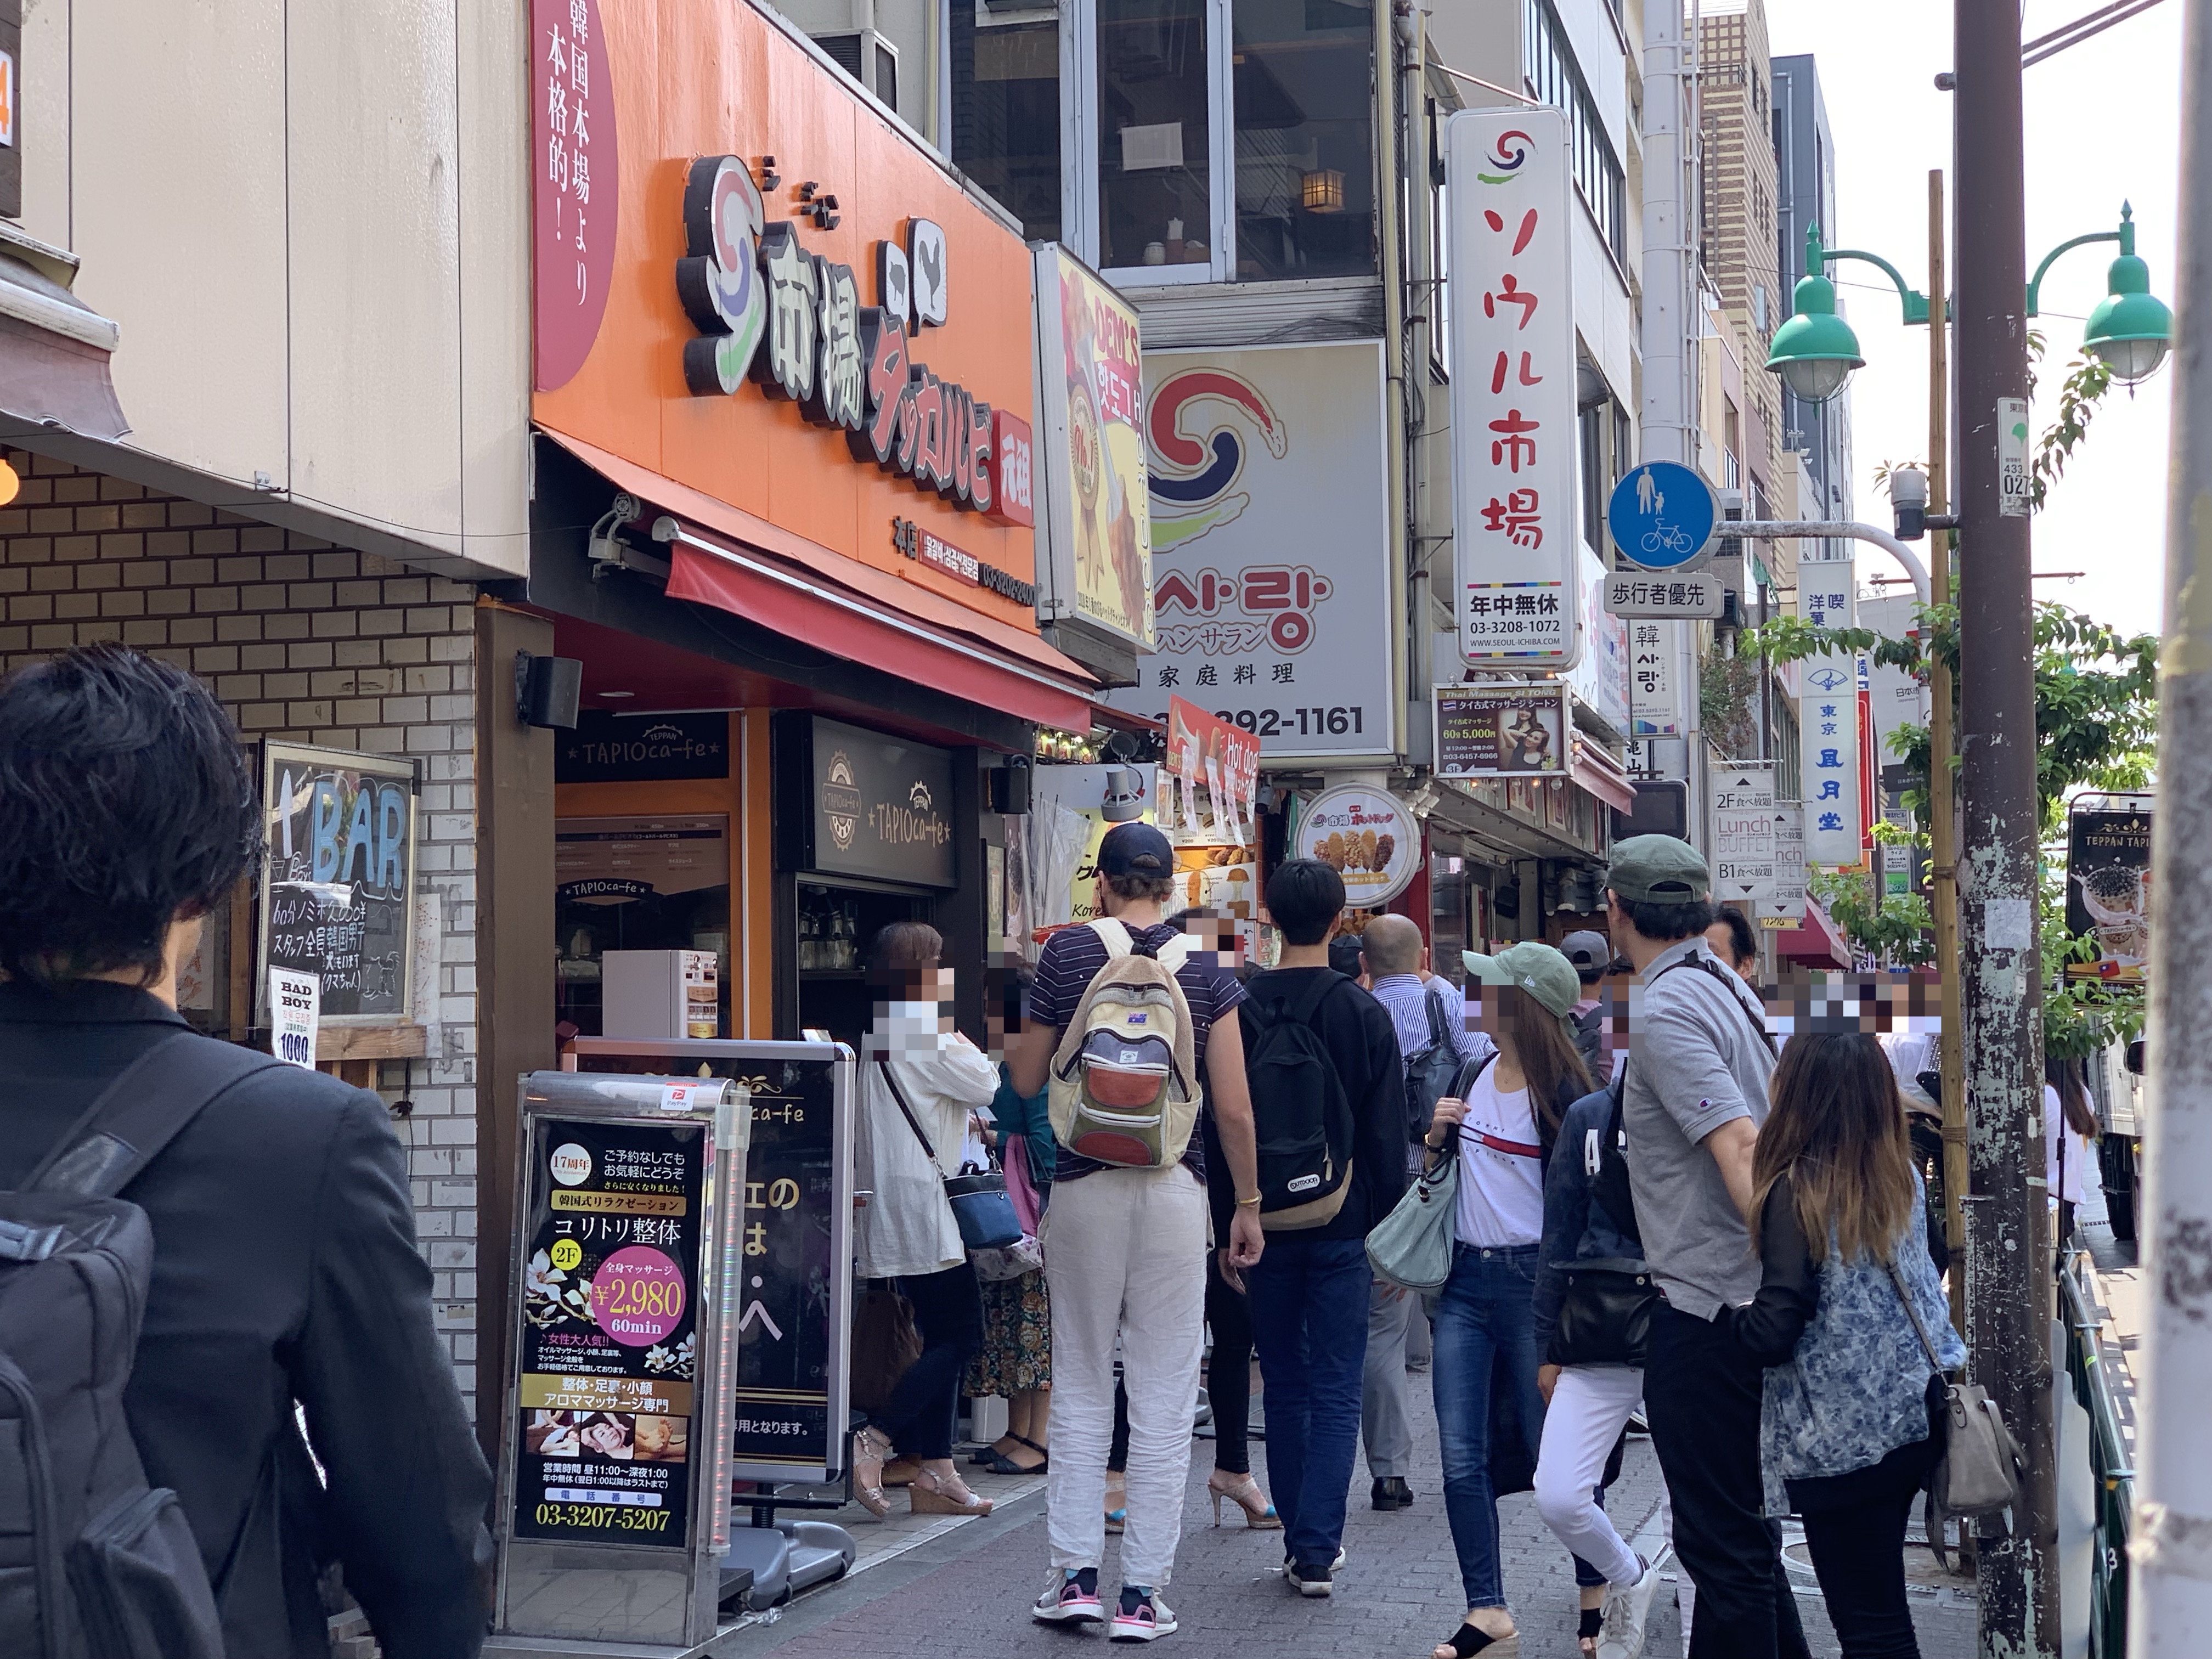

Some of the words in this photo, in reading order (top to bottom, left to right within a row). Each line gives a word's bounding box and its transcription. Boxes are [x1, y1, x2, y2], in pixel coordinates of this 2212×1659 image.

[546, 23, 568, 240] 本格的！
[569, 0, 590, 306] 韓国本場より
[769, 233, 861, 429] 市場
[1095, 296, 1138, 368] DEM'S
[1481, 209, 1543, 549] ソウル市場
[1098, 362, 1132, 426] 핫도그
[871, 314, 993, 511] タッカルビ
[1002, 432, 1031, 512] 元祖
[2004, 465, 2023, 473] 433
[894, 516, 917, 560] 本店
[1612, 582, 1705, 606] 歩行者優先
[1470, 594, 1559, 617] 年中無休
[1470, 620, 1560, 635] 03-3208-1072
[1470, 637, 1560, 647] WWW.SEOUL-ICHIBA.COM
[1137, 663, 1295, 687] 家庭料理
[1459, 700, 1526, 710] タイ古式マッサージ
[1528, 699, 1559, 708] シートン
[1820, 704, 1837, 736] 東京
[1443, 730, 1460, 739] 60分
[1462, 729, 1496, 740] 5,000円
[583, 738, 706, 764] TAPIOca-fe
[1227, 733, 1243, 771] Hot
[1243, 741, 1259, 777] dog
[1447, 764, 1461, 772] 3F
[1717, 794, 1735, 809] 2F
[1736, 797, 1772, 807] 食べ放題
[876, 802, 944, 848] TAPIOca-fe
[1718, 815, 1771, 833] Lunch
[313, 781, 407, 889] BAR
[2085, 836, 2123, 847] TEPPAN
[2126, 837, 2151, 848] TAPI
[1718, 837, 1772, 853] BUFFET
[1775, 846, 1802, 861] nch
[1719, 864, 1734, 878] B1
[1737, 867, 1773, 877] 食べ放題
[572, 881, 637, 895] TAPIOca-fe
[1072, 904, 1102, 917] Kore
[281, 981, 312, 996] BAD
[282, 996, 312, 1011] BOY
[280, 1032, 309, 1064] 1000
[752, 1103, 805, 1125] ca-fe
[553, 1155, 590, 1170] 17周年
[604, 1149, 685, 1165] ご予約なしでも
[604, 1164, 685, 1180] お気軽にどうぞ
[604, 1181, 685, 1193] さらに安くなりました！
[558, 1194, 679, 1211] 韓国式リラクゼーション
[555, 1216, 682, 1245] コリトリ整体
[556, 1246, 578, 1263] 2F
[606, 1261, 673, 1276] 全身マッサージ
[594, 1278, 682, 1318] ¥2,980
[611, 1318, 663, 1335] 60min
[544, 1393, 670, 1414] アロママッサージ専門
[543, 1462, 582, 1475] 営業時間
[560, 1489, 646, 1504] 電話番号
[535, 1503, 672, 1532] 03-3207-5207
